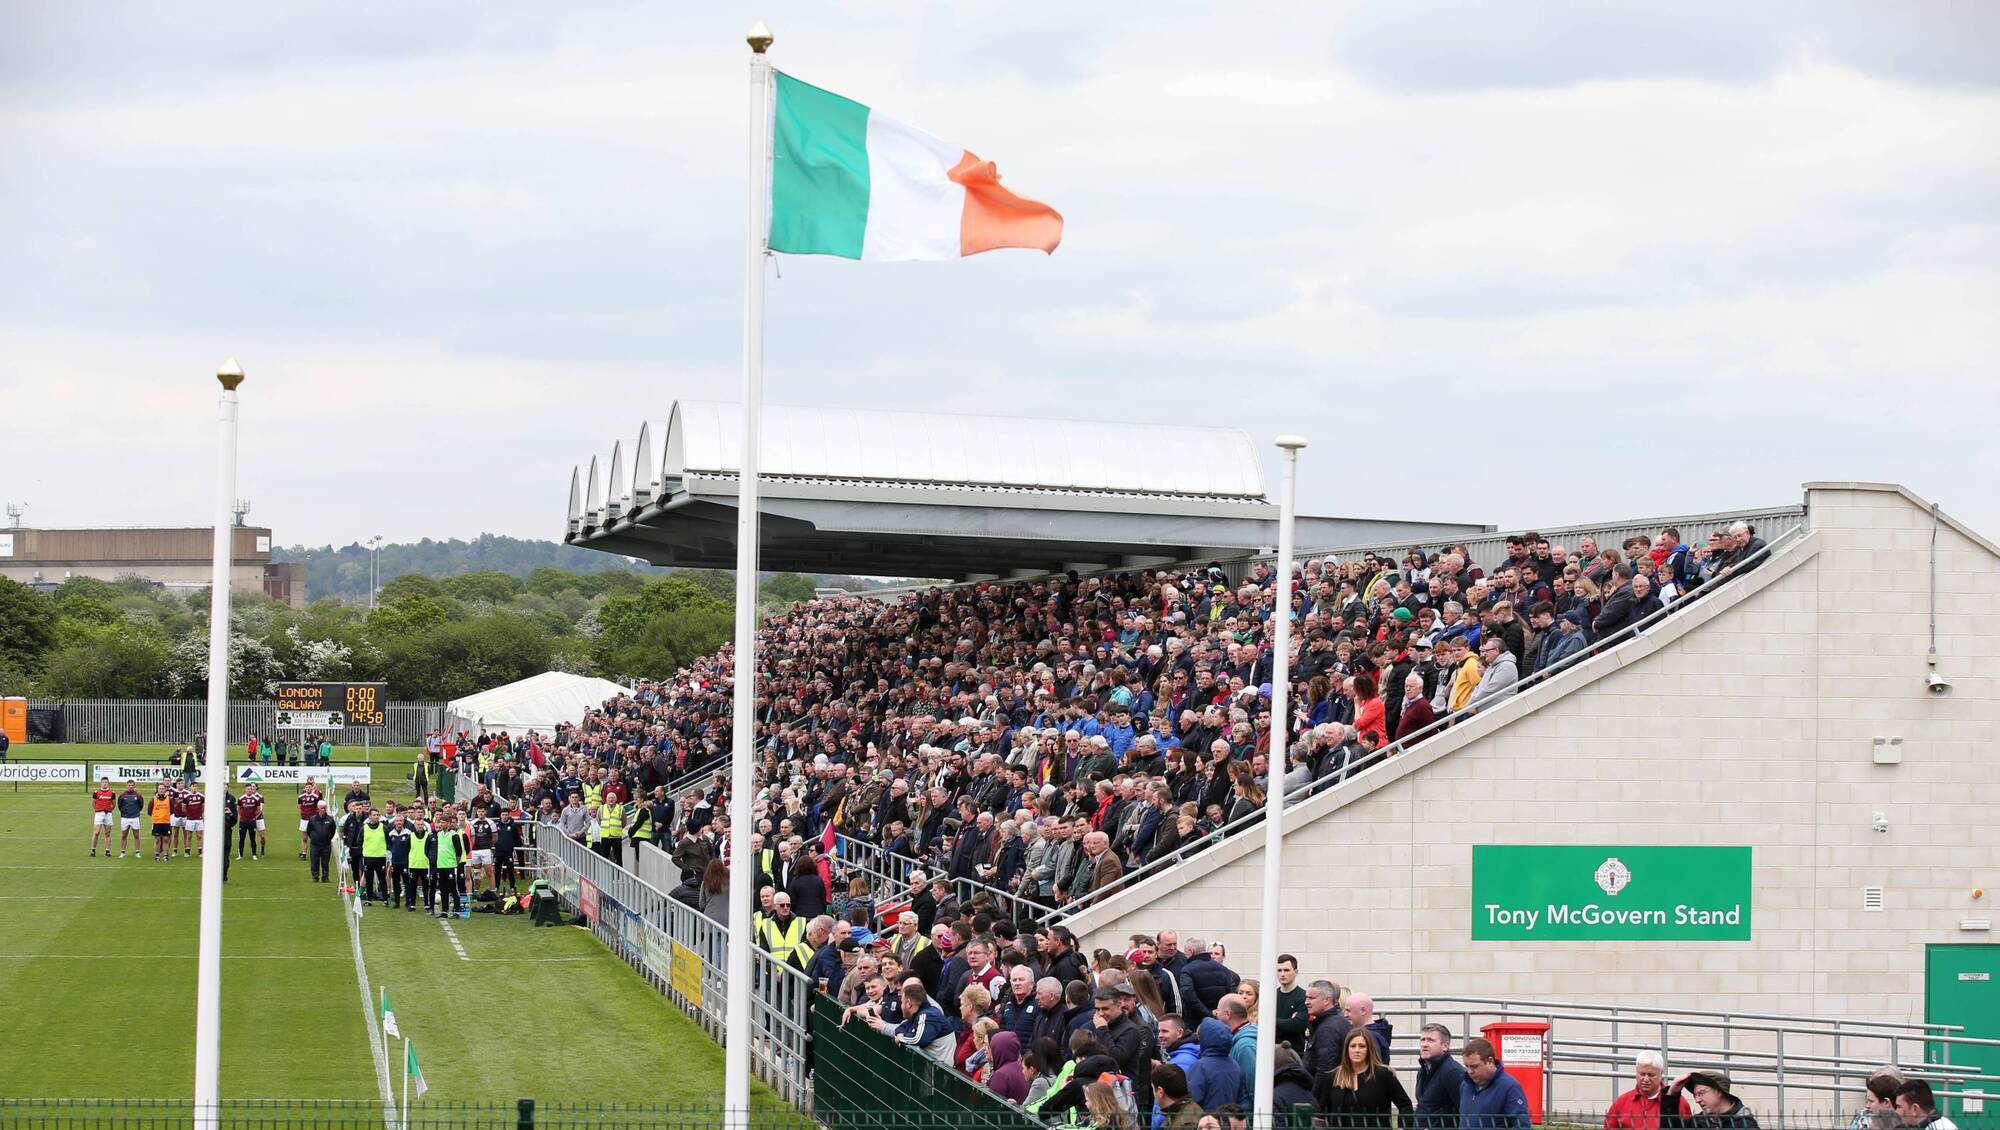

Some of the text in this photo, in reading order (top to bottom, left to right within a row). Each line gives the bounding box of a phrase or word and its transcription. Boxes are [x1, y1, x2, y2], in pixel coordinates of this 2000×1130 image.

[279, 687, 322, 698] LONDON
[279, 700, 322, 710] GALWAY
[351, 711, 383, 724] 14:58
[118, 767, 150, 778] IRISH
[264, 769, 299, 778] DEANE
[1484, 904, 1740, 930] Tony McGovern Stand
